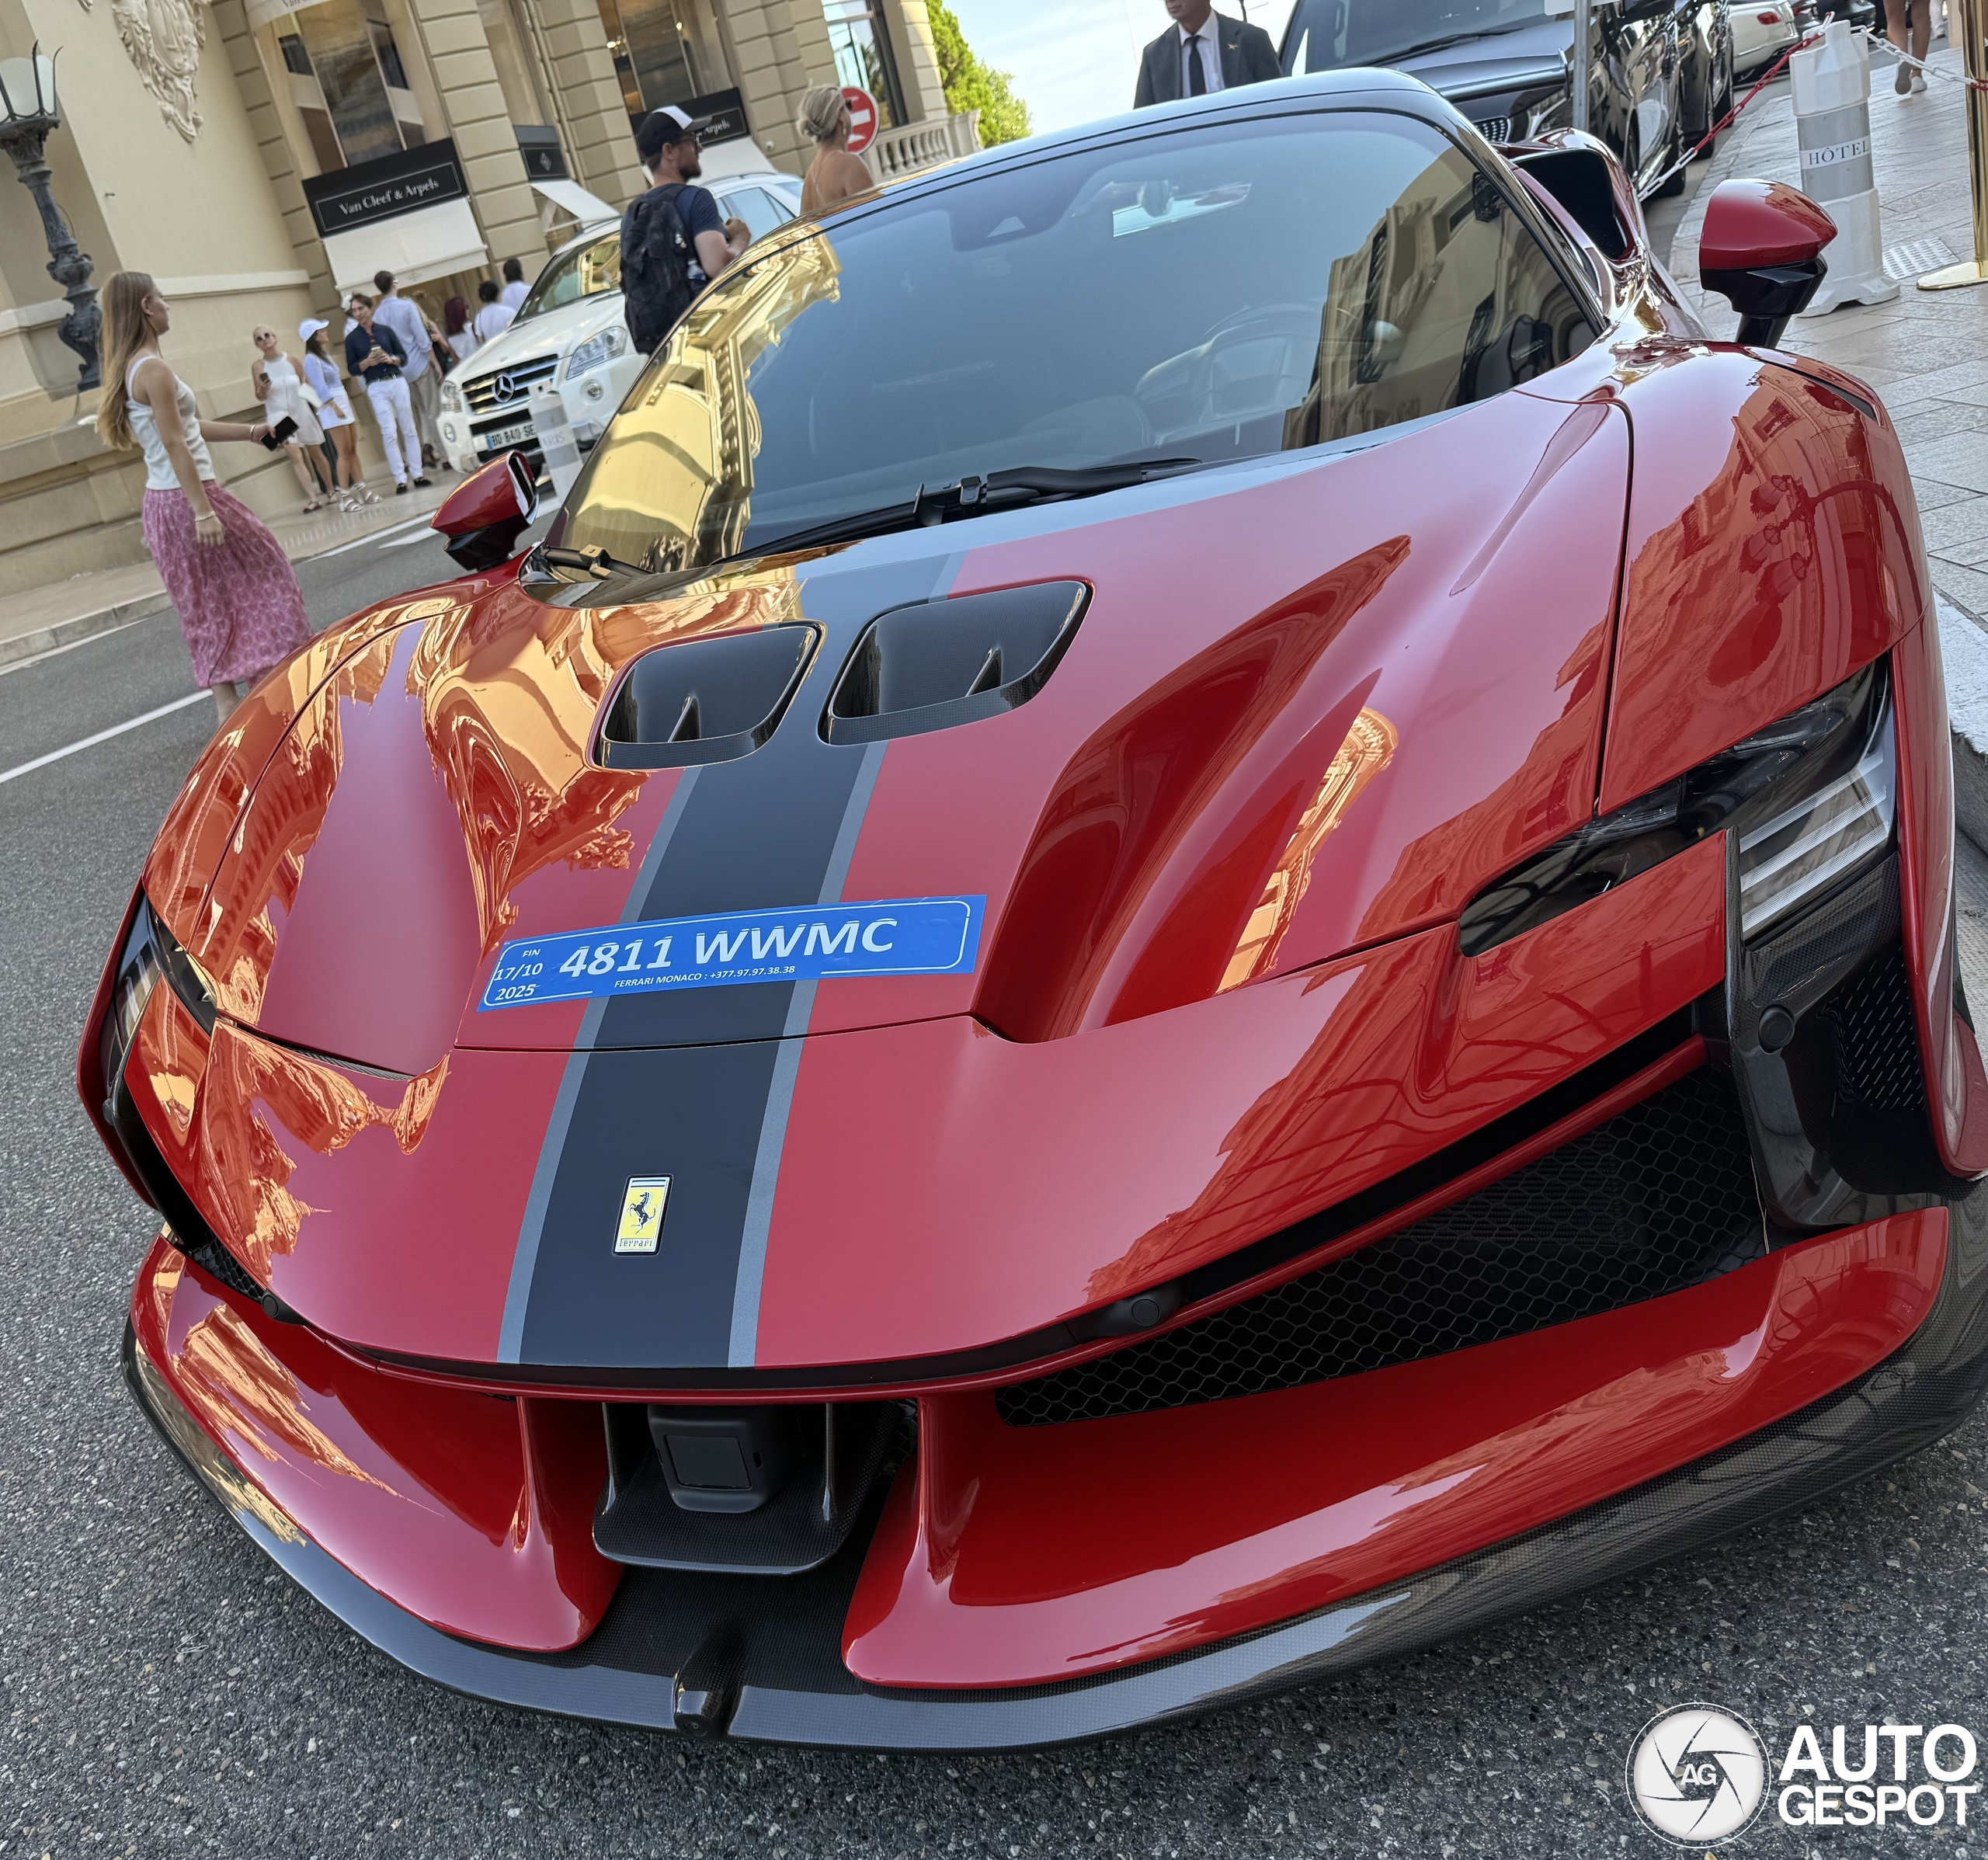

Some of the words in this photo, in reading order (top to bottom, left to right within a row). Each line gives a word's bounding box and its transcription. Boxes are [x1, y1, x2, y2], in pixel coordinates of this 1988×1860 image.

[1809, 141, 1869, 165] HÔTEL
[339, 203, 363, 215] Van
[362, 189, 392, 209] Cleef
[394, 190, 404, 200] &
[405, 177, 440, 197] Arpels
[522, 948, 541, 958] FIN
[559, 936, 673, 978] 4811
[696, 918, 898, 965] WWMC
[494, 962, 544, 981] 17/10
[613, 977, 654, 988] FERRARI
[655, 972, 702, 984] MONACO
[710, 965, 796, 979] +377.97.97.38.38
[495, 984, 537, 1001] 2025
[619, 1237, 653, 1247] Ferrari
